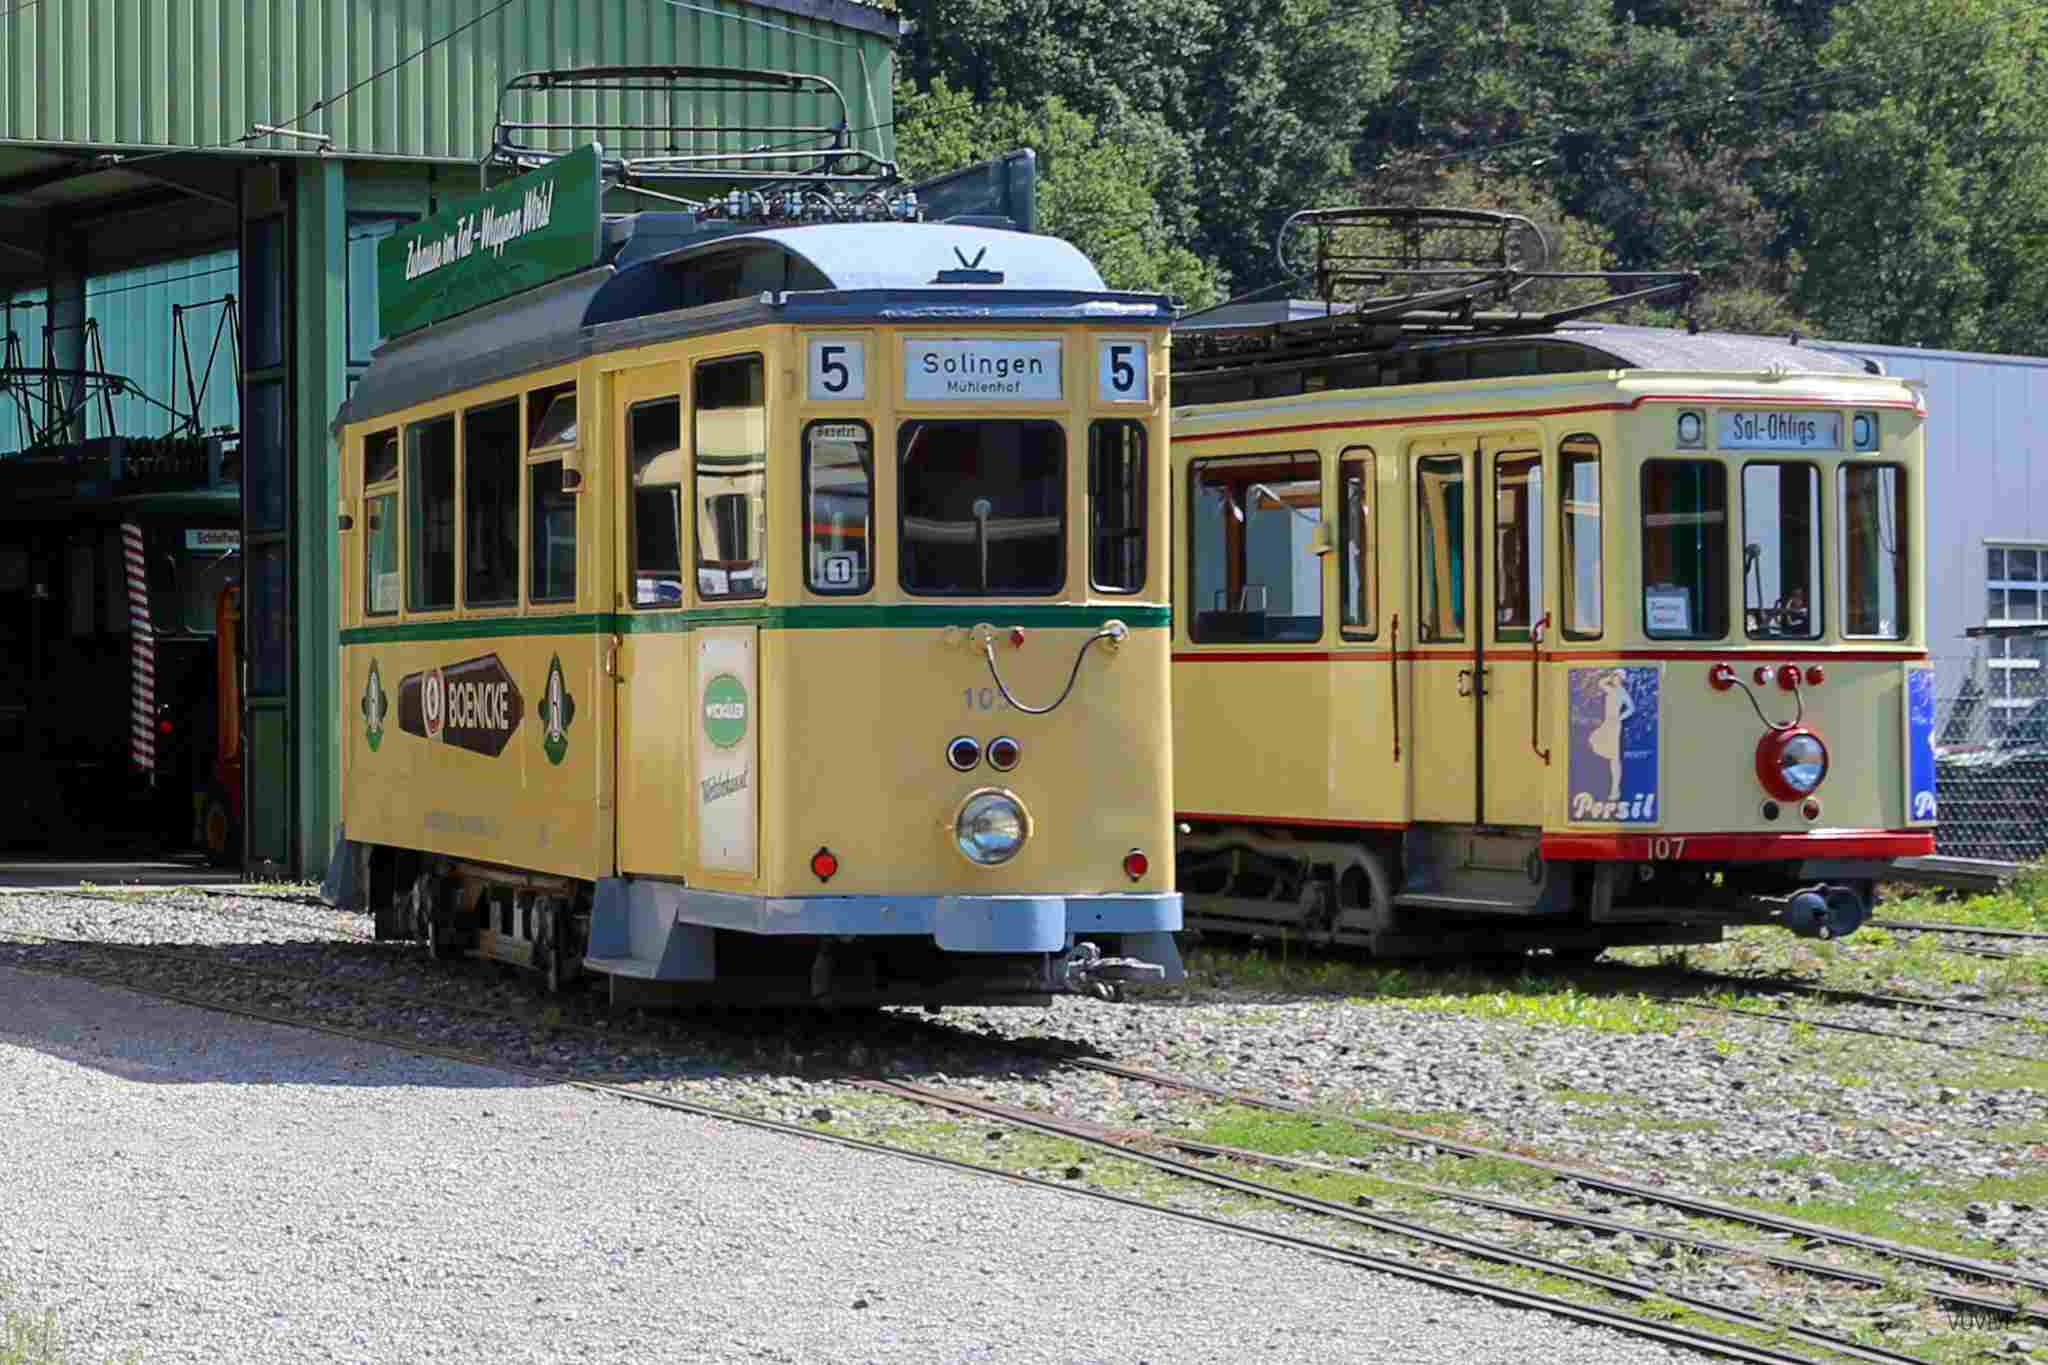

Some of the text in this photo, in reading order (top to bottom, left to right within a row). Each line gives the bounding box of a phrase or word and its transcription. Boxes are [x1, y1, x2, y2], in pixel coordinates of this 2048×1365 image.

[820, 346, 849, 393] 5
[922, 352, 1043, 378] Solingen
[1111, 346, 1136, 392] 5
[835, 561, 844, 581] 1
[448, 681, 510, 731] BOENICKE
[1573, 792, 1656, 819] Persil
[1648, 837, 1685, 860] 107
